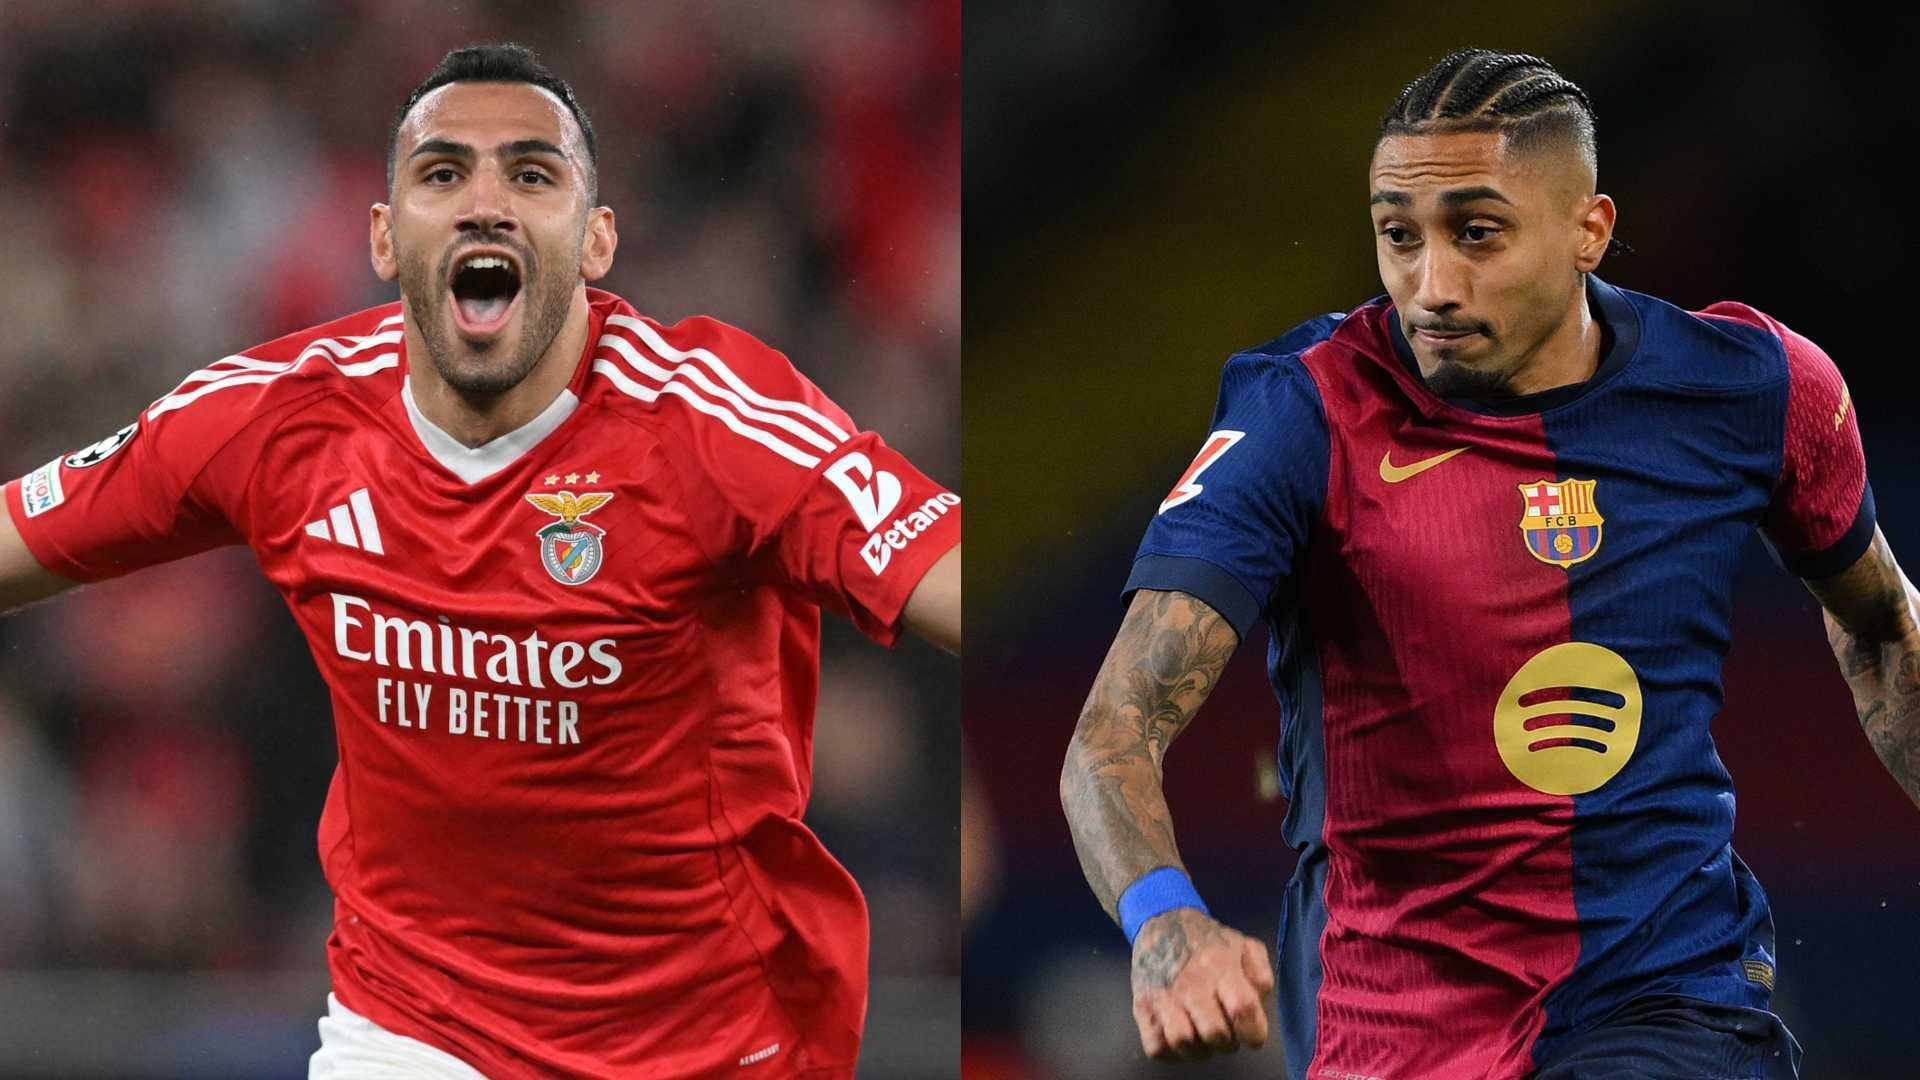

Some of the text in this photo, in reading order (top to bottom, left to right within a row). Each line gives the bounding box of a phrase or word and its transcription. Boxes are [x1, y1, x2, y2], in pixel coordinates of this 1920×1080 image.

[860, 492, 961, 576] Betano
[330, 592, 623, 689] Emirates
[377, 677, 581, 745] FLY BETTER
